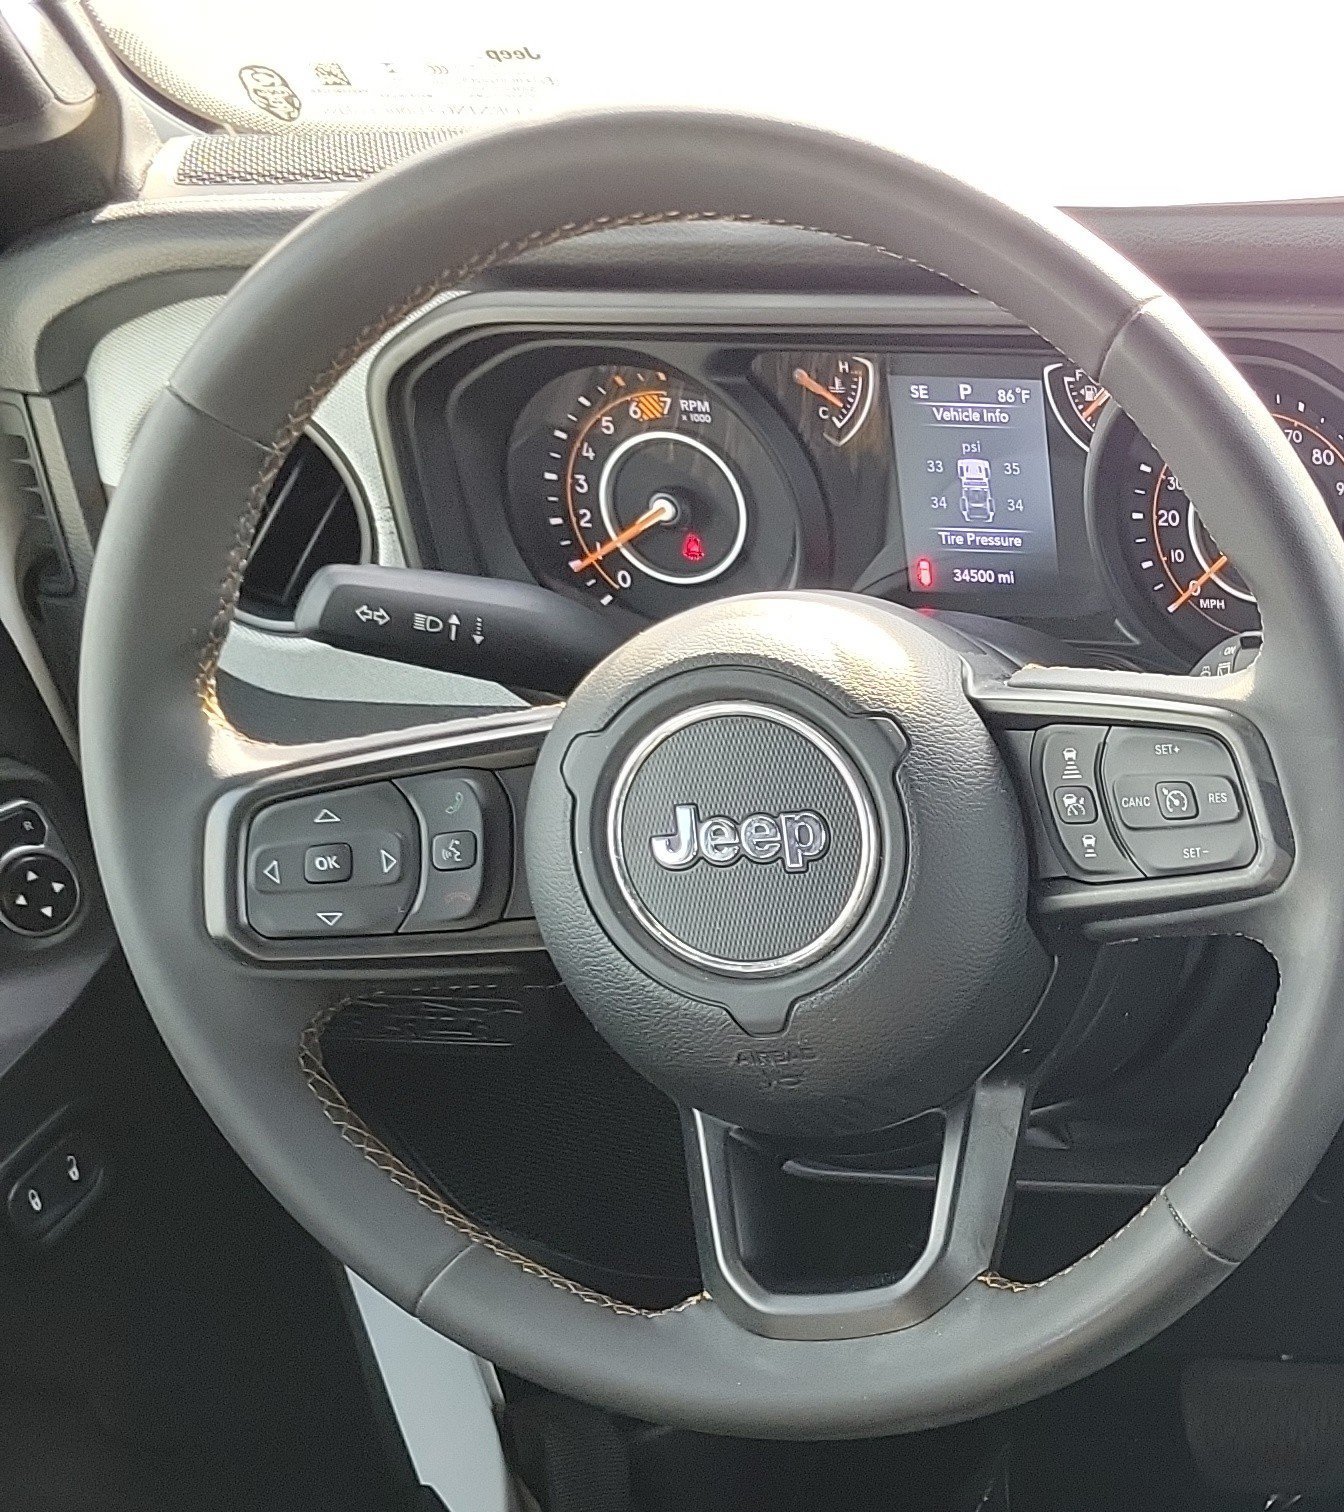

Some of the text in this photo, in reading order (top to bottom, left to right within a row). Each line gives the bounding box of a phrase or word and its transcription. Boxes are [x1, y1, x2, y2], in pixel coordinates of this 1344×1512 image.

[839, 361, 849, 373] H
[910, 384, 929, 399] SE
[959, 384, 972, 400] P
[629, 402, 641, 419] 6
[662, 397, 671, 415] 7
[680, 399, 711, 413] RPM
[818, 406, 829, 419] C
[688, 413, 711, 424] 1000
[933, 408, 1009, 424] Vehicle Info
[601, 417, 614, 434] 5
[582, 443, 595, 460] 4
[962, 440, 981, 456] psi
[1312, 449, 1335, 466] 80
[927, 461, 943, 473] 33
[1004, 463, 1021, 476] 35
[575, 474, 589, 493] 3
[931, 497, 947, 509] 34
[1007, 499, 1023, 512] 34
[579, 509, 592, 527] 2
[1158, 511, 1180, 526] 20
[939, 532, 1022, 548] Tire Pressure
[1170, 548, 1184, 563] 10
[618, 570, 632, 588] 0
[953, 569, 1015, 584] 34500 mi
[1200, 599, 1225, 611] MPH
[1122, 796, 1151, 808] CANC
[1208, 792, 1227, 804] RES
[651, 803, 830, 872] Jeep
[315, 855, 340, 871] OK
